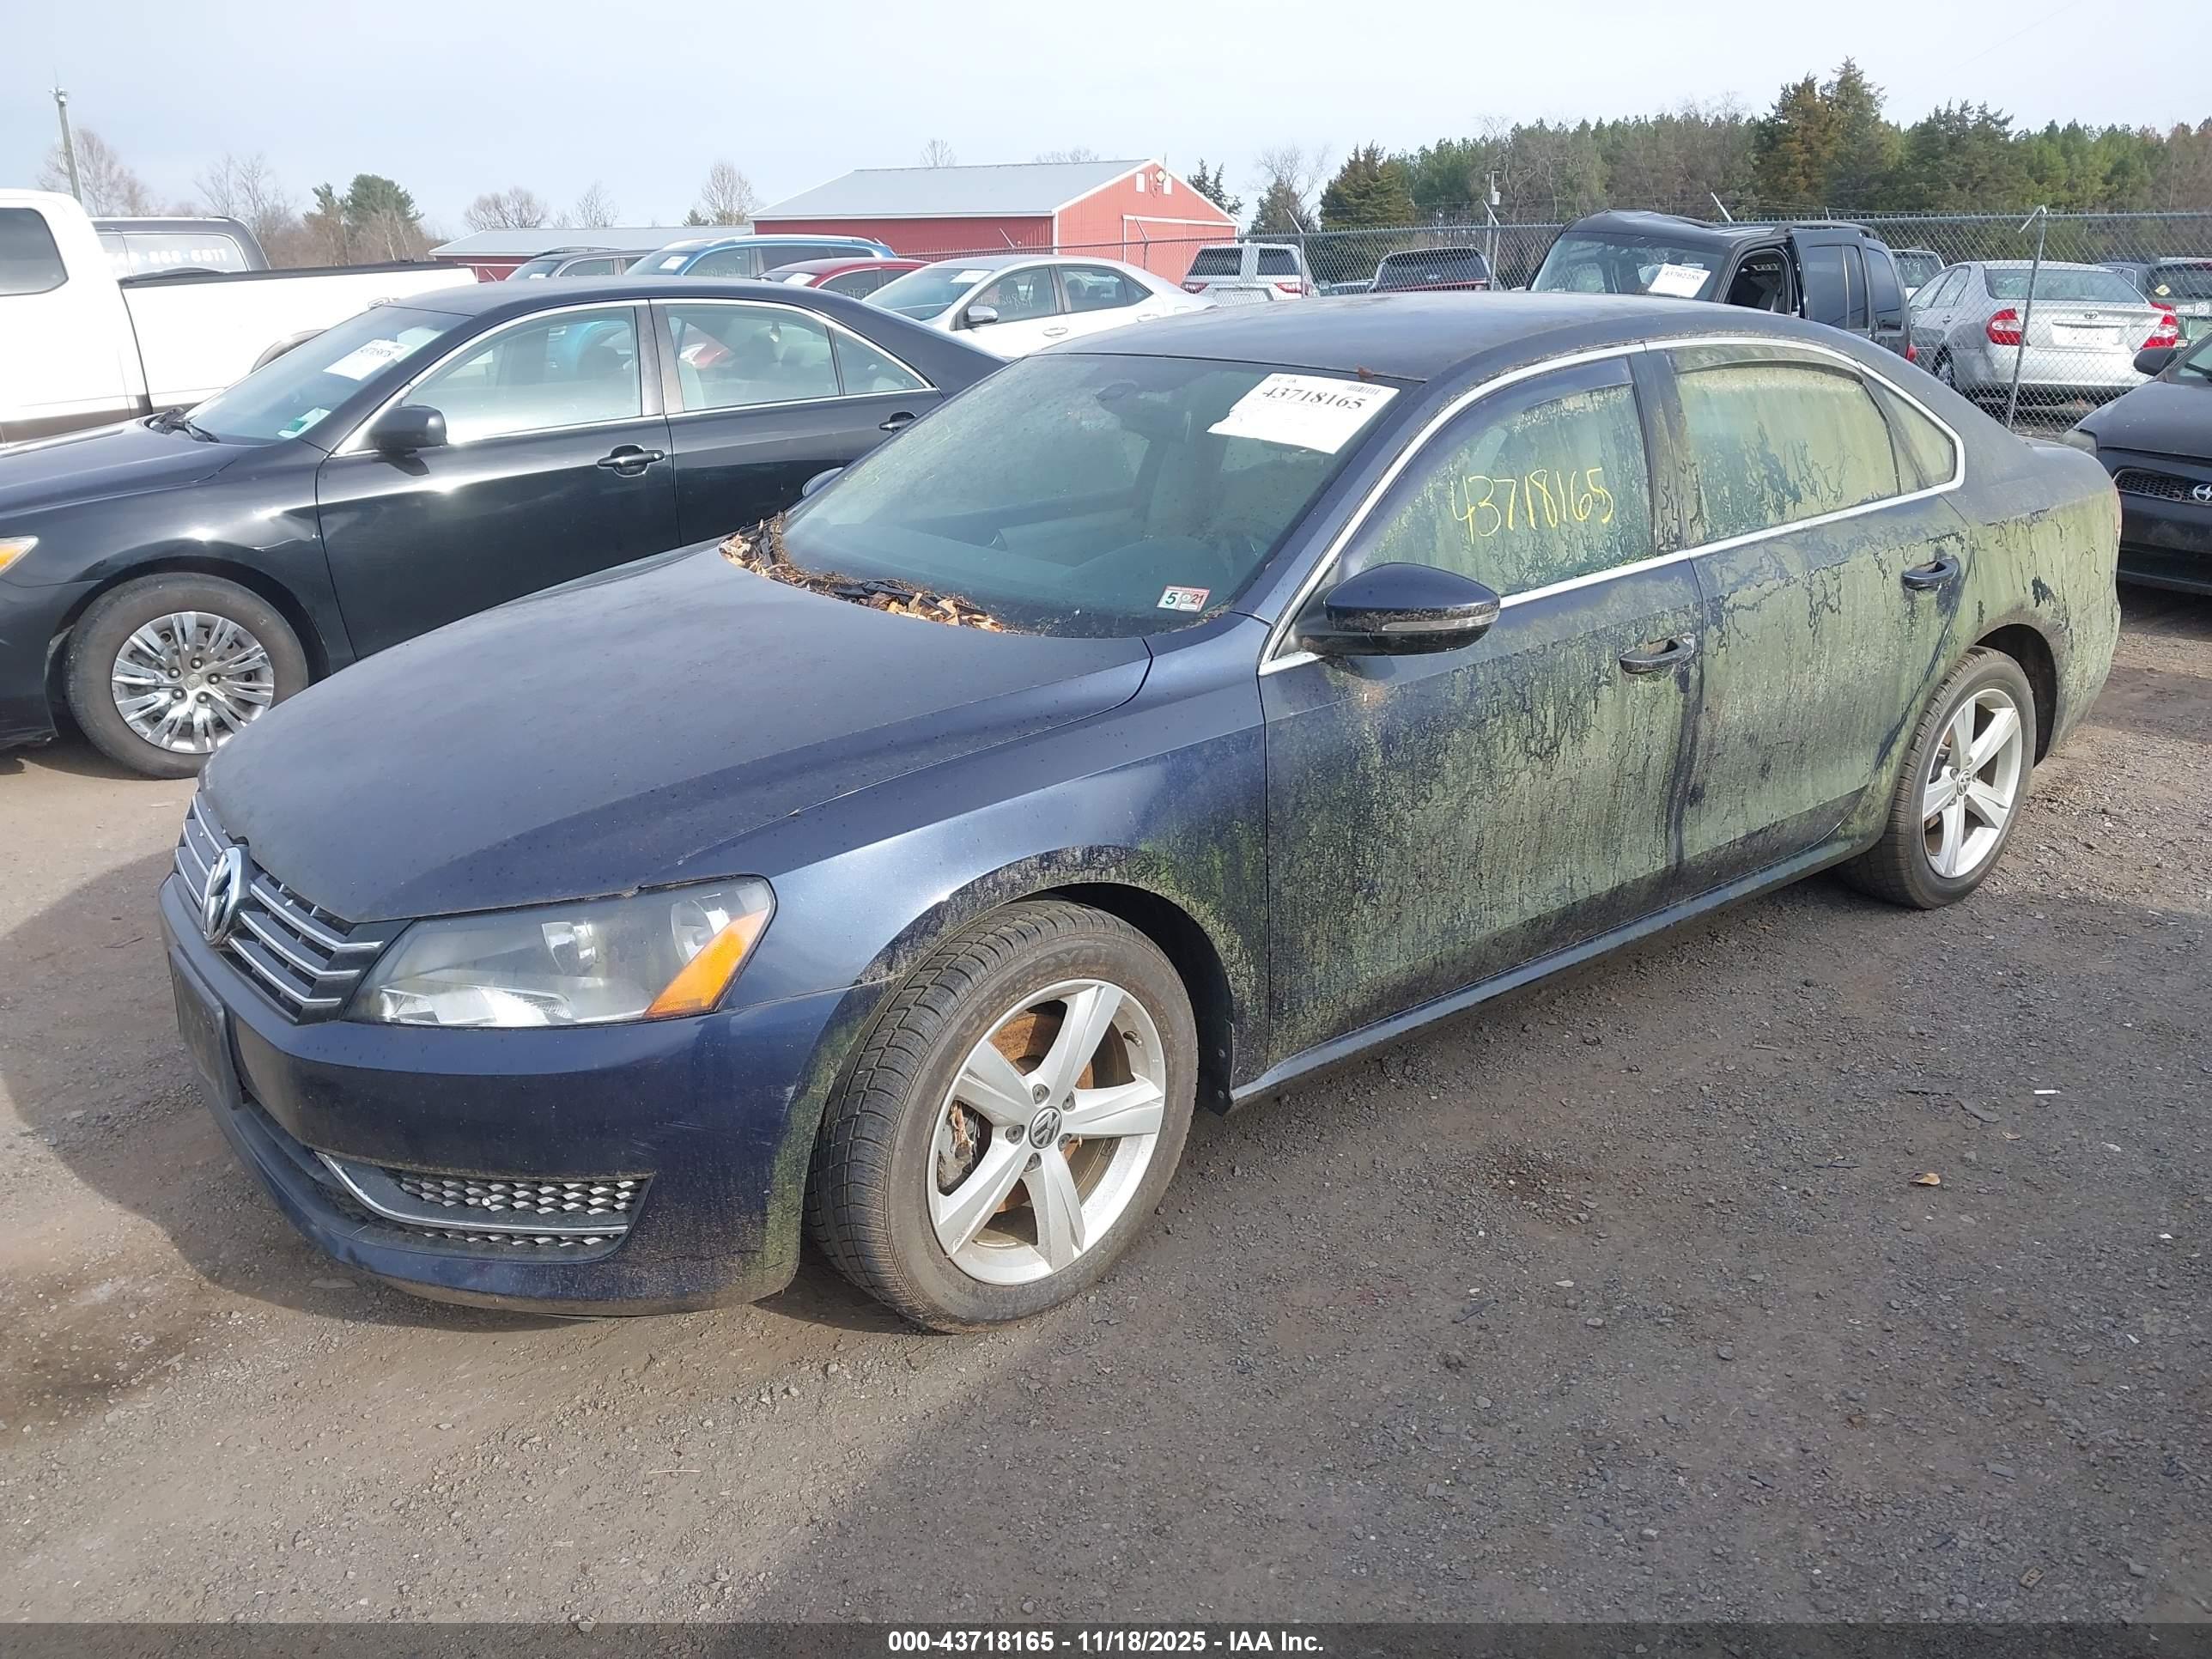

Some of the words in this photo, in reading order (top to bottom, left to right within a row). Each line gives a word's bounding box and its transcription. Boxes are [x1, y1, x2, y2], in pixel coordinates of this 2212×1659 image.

[1262, 386, 1367, 410] 43718165
[1450, 467, 1614, 544] 43718165
[1164, 591, 1178, 605] 5
[1189, 593, 1205, 605] 21
